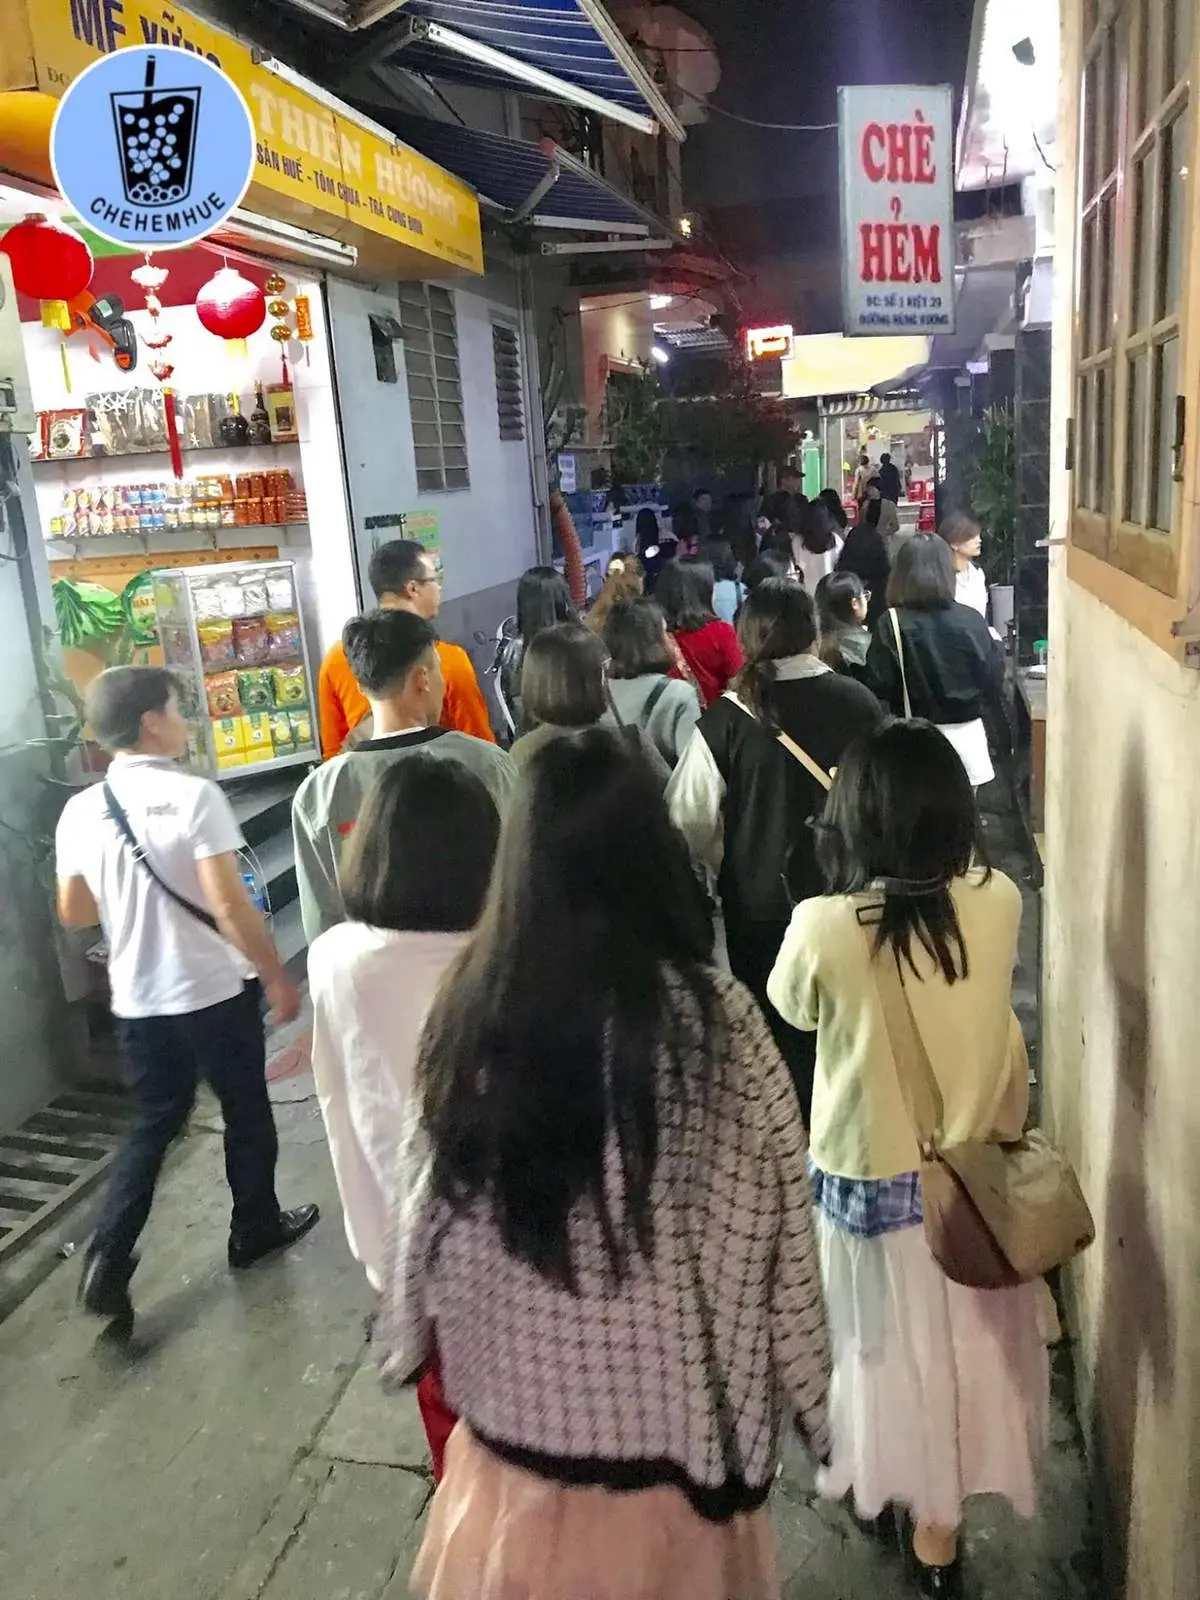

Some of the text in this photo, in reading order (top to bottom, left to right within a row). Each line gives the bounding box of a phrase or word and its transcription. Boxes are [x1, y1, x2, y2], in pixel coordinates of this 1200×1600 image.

[250, 83, 363, 181] THIÊN
[256, 139, 280, 172] SẢN
[282, 156, 304, 183] HUẾ
[313, 169, 336, 197] TÔM
[861, 108, 936, 184] CHÈ
[860, 196, 942, 284] HẺM
[906, 293, 928, 309] KIỆT
